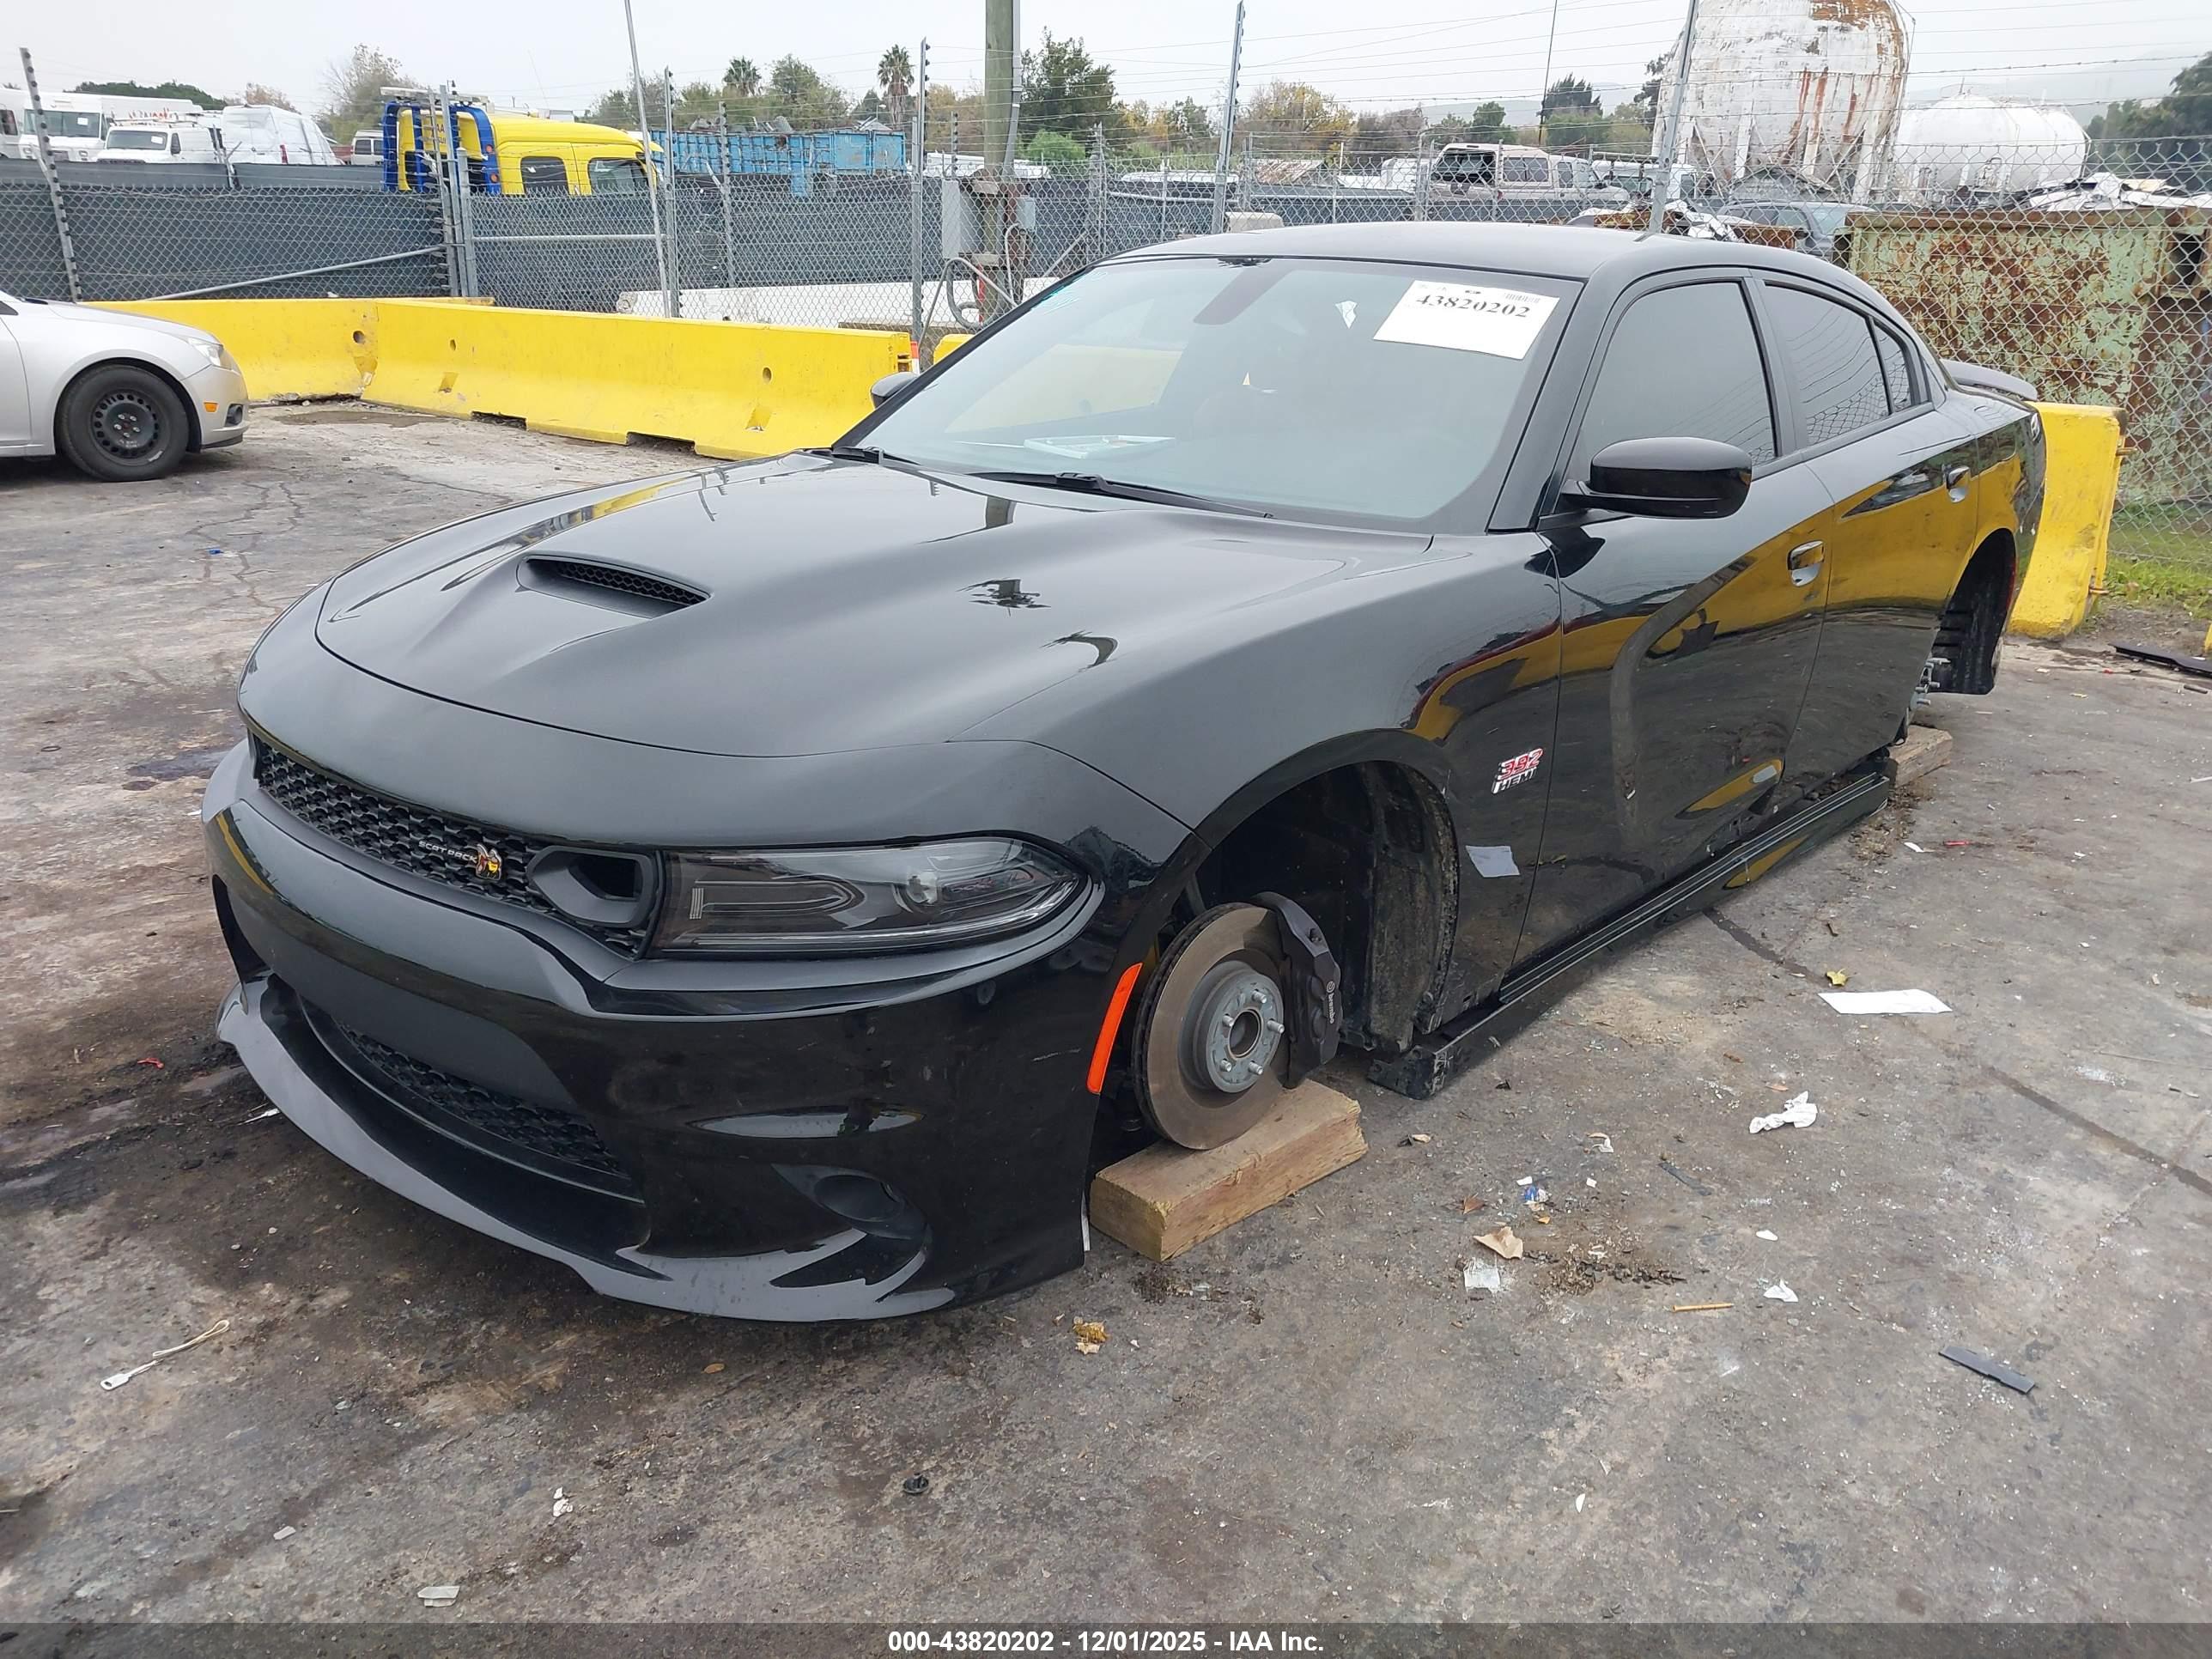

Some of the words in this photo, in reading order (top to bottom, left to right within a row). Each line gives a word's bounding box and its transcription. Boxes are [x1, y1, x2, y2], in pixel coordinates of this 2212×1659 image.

[1415, 294, 1530, 318] 43820202
[1497, 748, 1543, 781] 392
[418, 841, 447, 854] SCAT
[447, 849, 477, 864] PACK
[1328, 992, 1336, 1024] brembo
